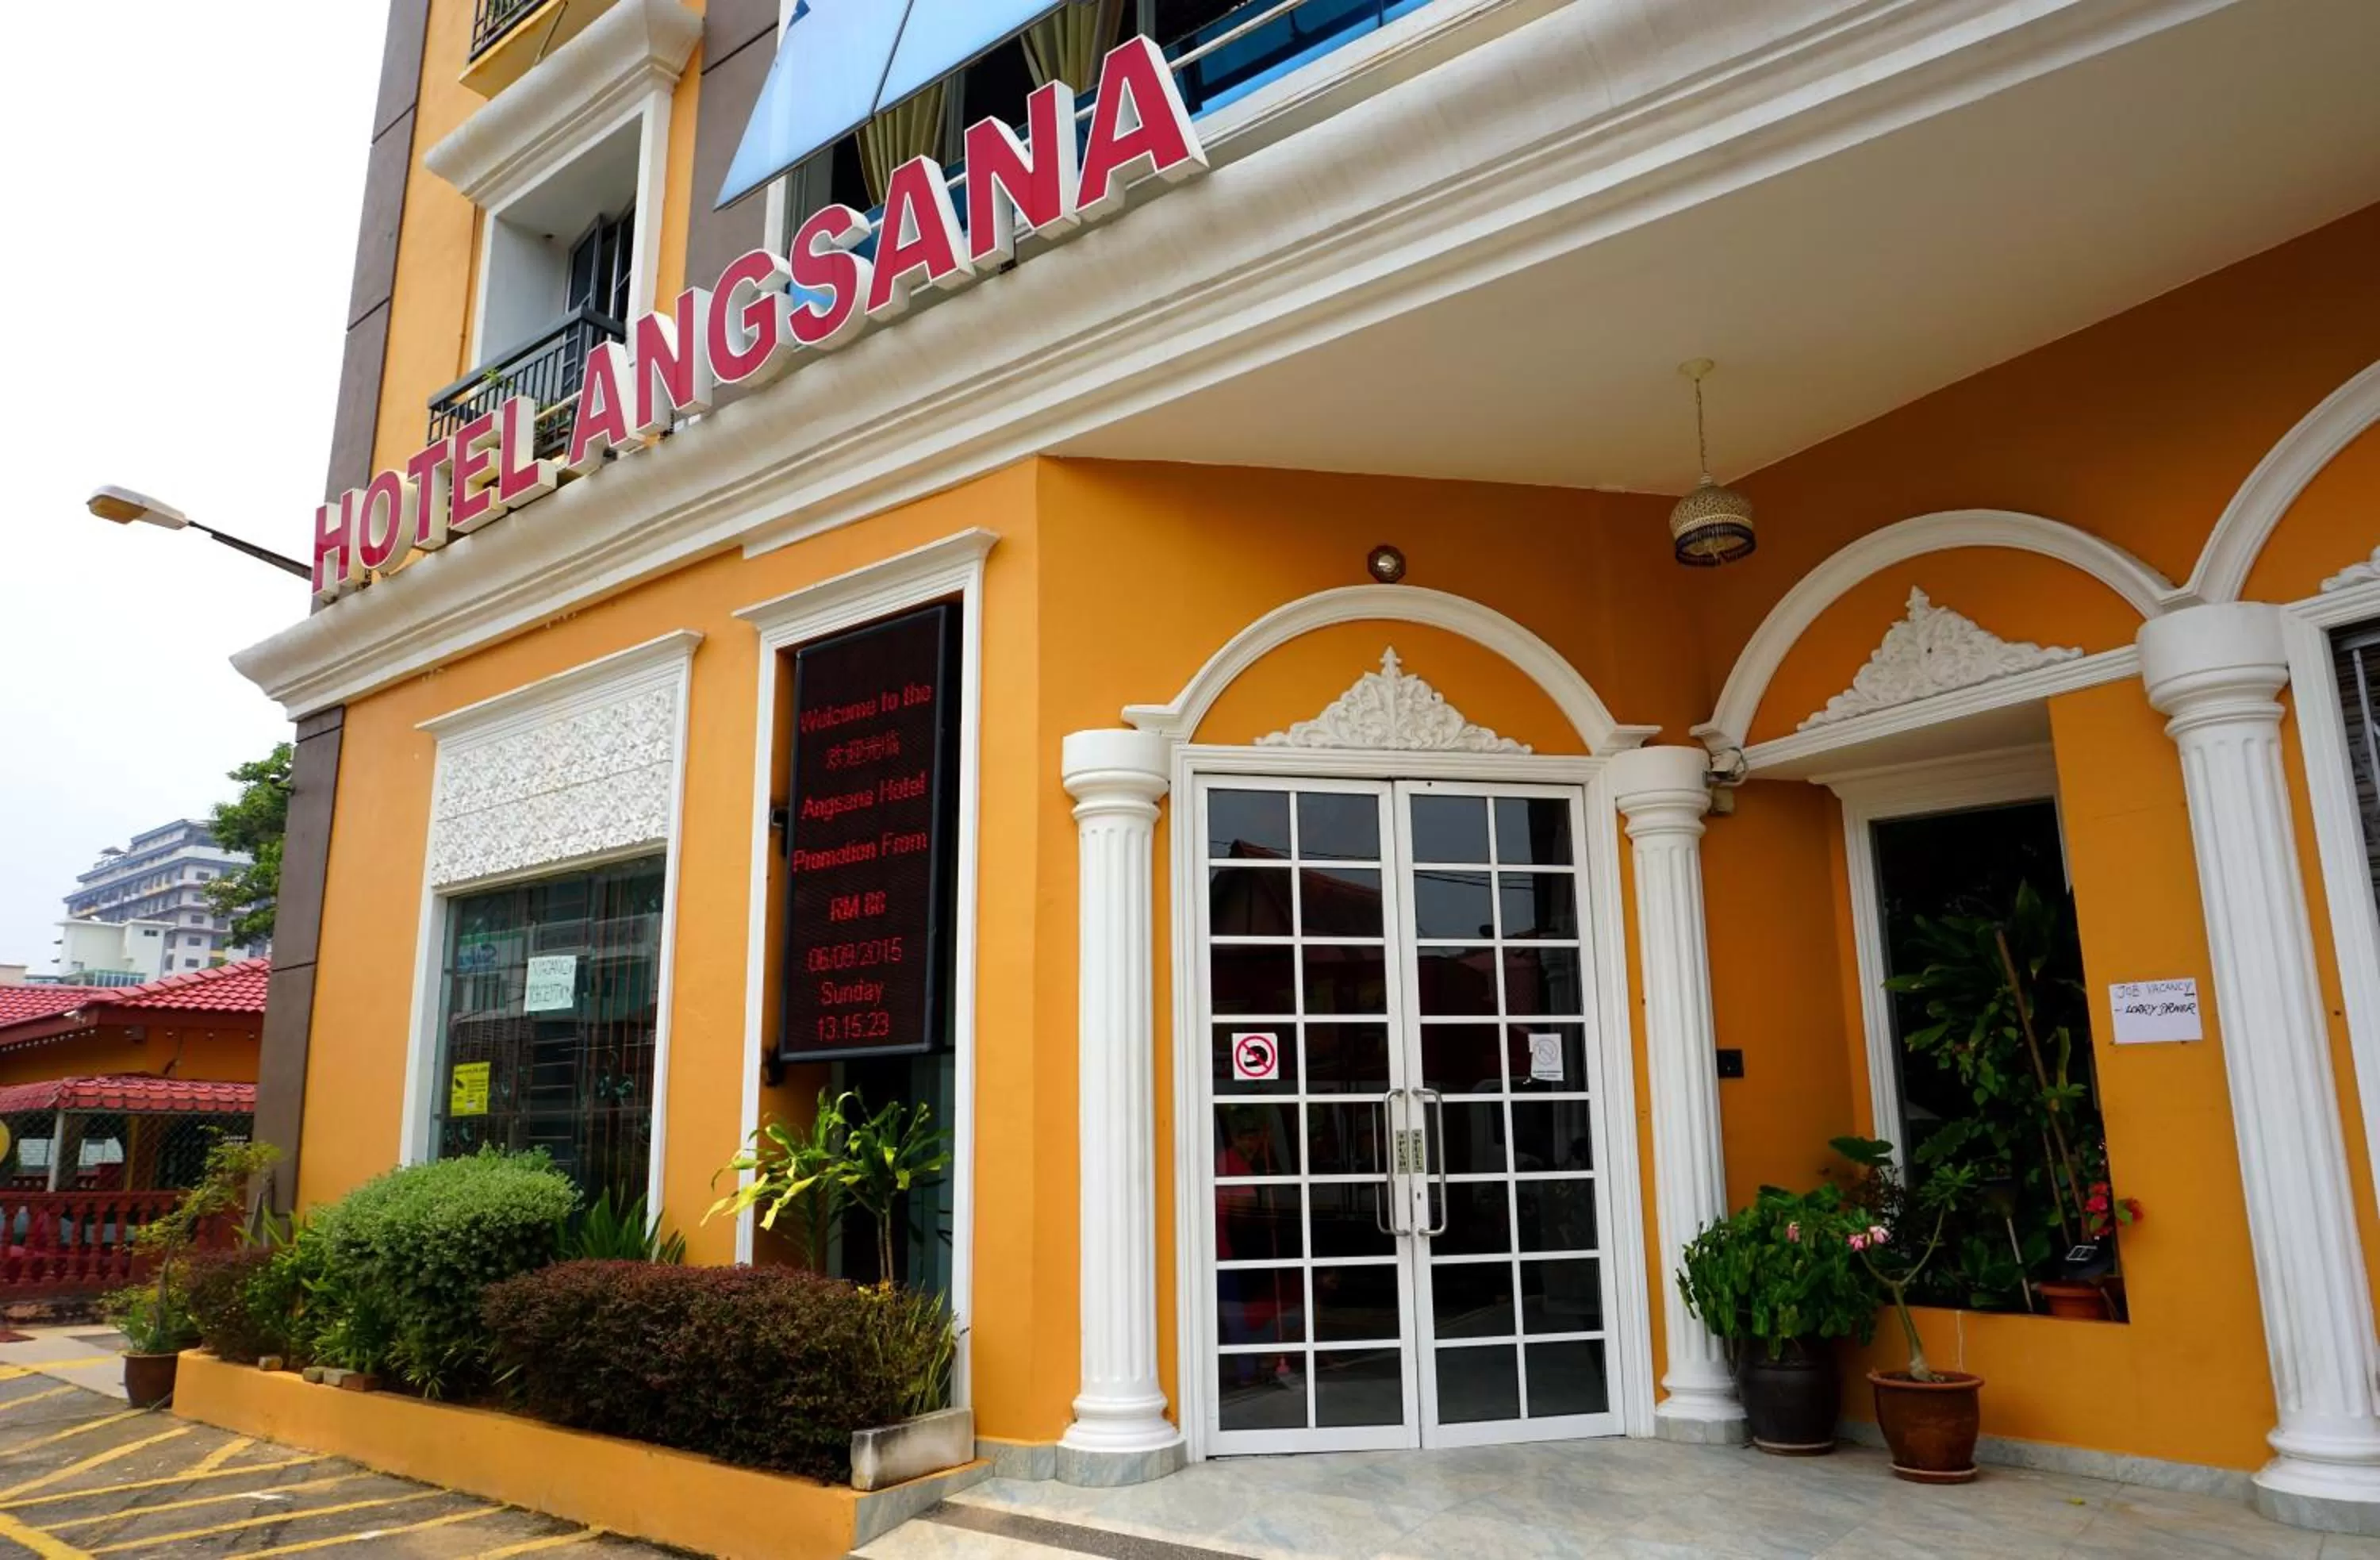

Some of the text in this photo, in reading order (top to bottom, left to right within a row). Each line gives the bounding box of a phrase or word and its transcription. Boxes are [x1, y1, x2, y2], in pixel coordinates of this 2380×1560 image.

[312, 34, 1207, 599] HOTEL ANGSANA
[800, 683, 931, 734] Welcome to the
[800, 771, 927, 821] Angsana Hotel
[793, 832, 927, 871] Promotion From
[831, 895, 860, 920] RM
[821, 978, 885, 1007] Sunday
[2146, 981, 2193, 993] VACANCY
